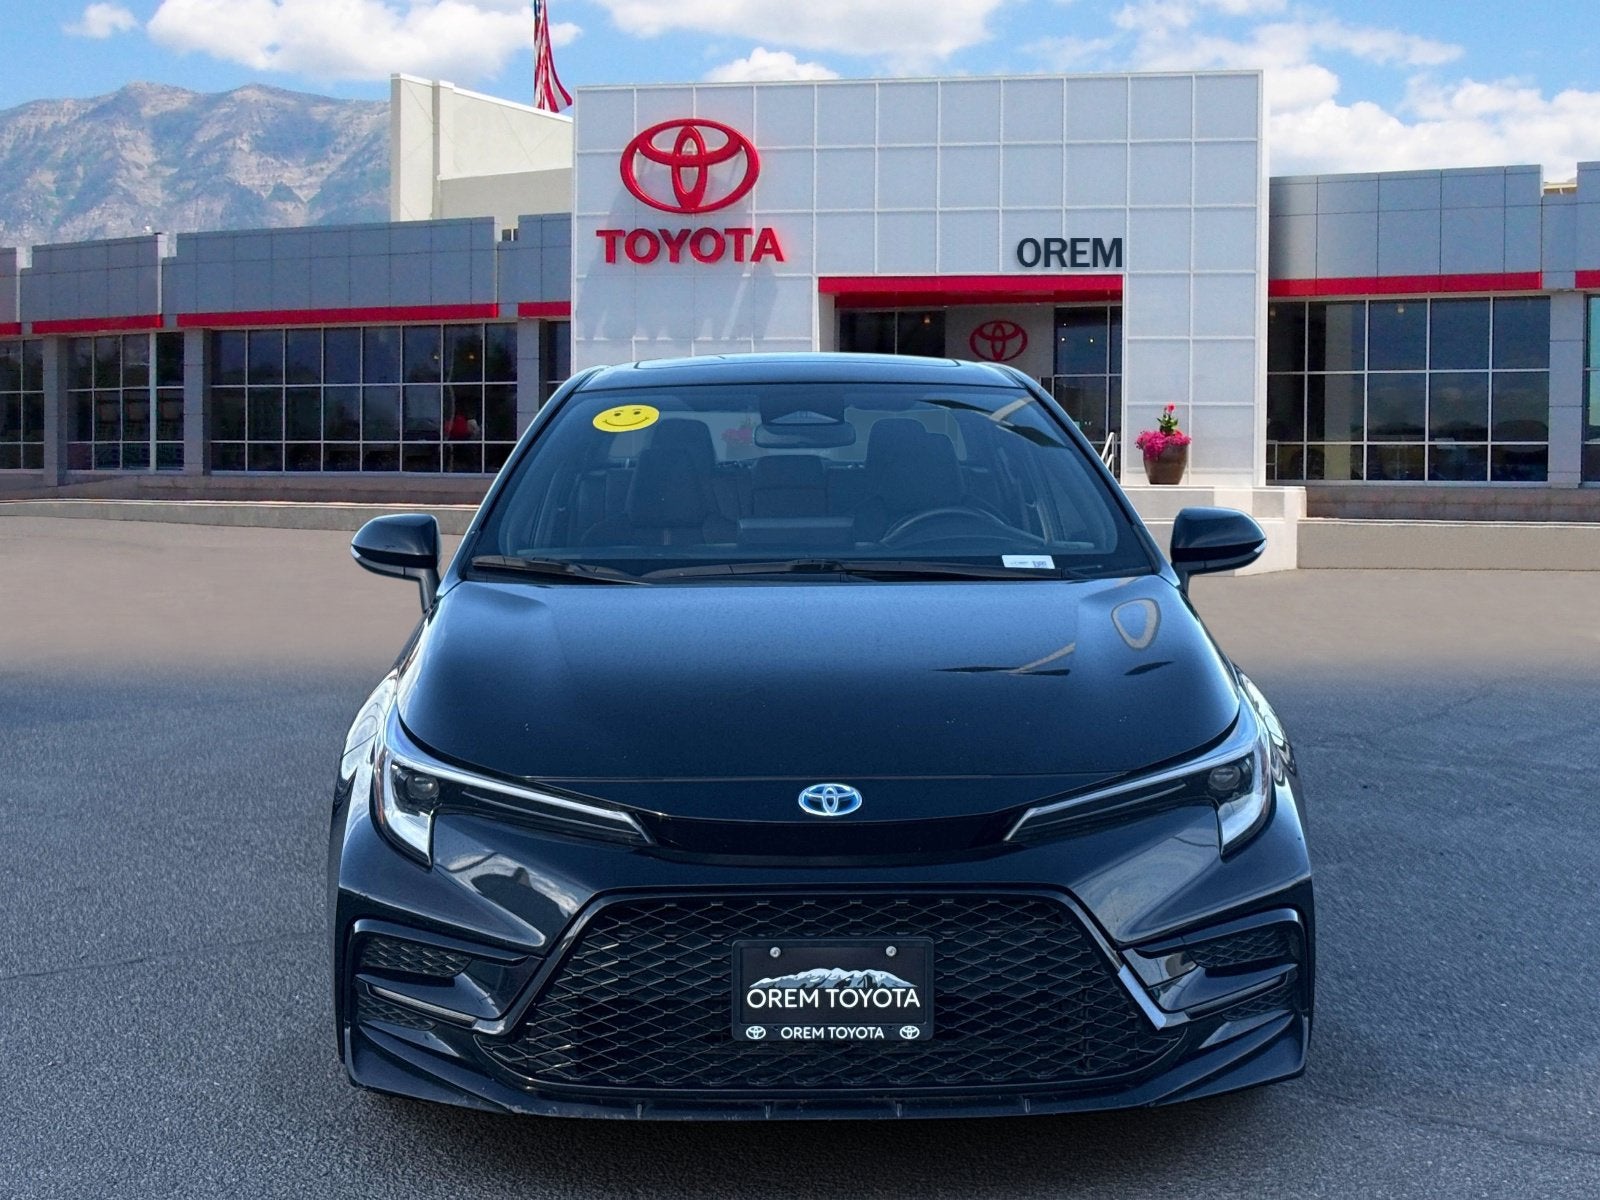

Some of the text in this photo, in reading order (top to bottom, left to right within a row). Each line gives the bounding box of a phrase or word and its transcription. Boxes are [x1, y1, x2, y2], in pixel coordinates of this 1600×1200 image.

[596, 227, 785, 264] TOYOTA
[1016, 237, 1123, 268] OREM
[746, 988, 920, 1008] OREM TOYOTA
[780, 1026, 884, 1040] OREM TOYOTA
